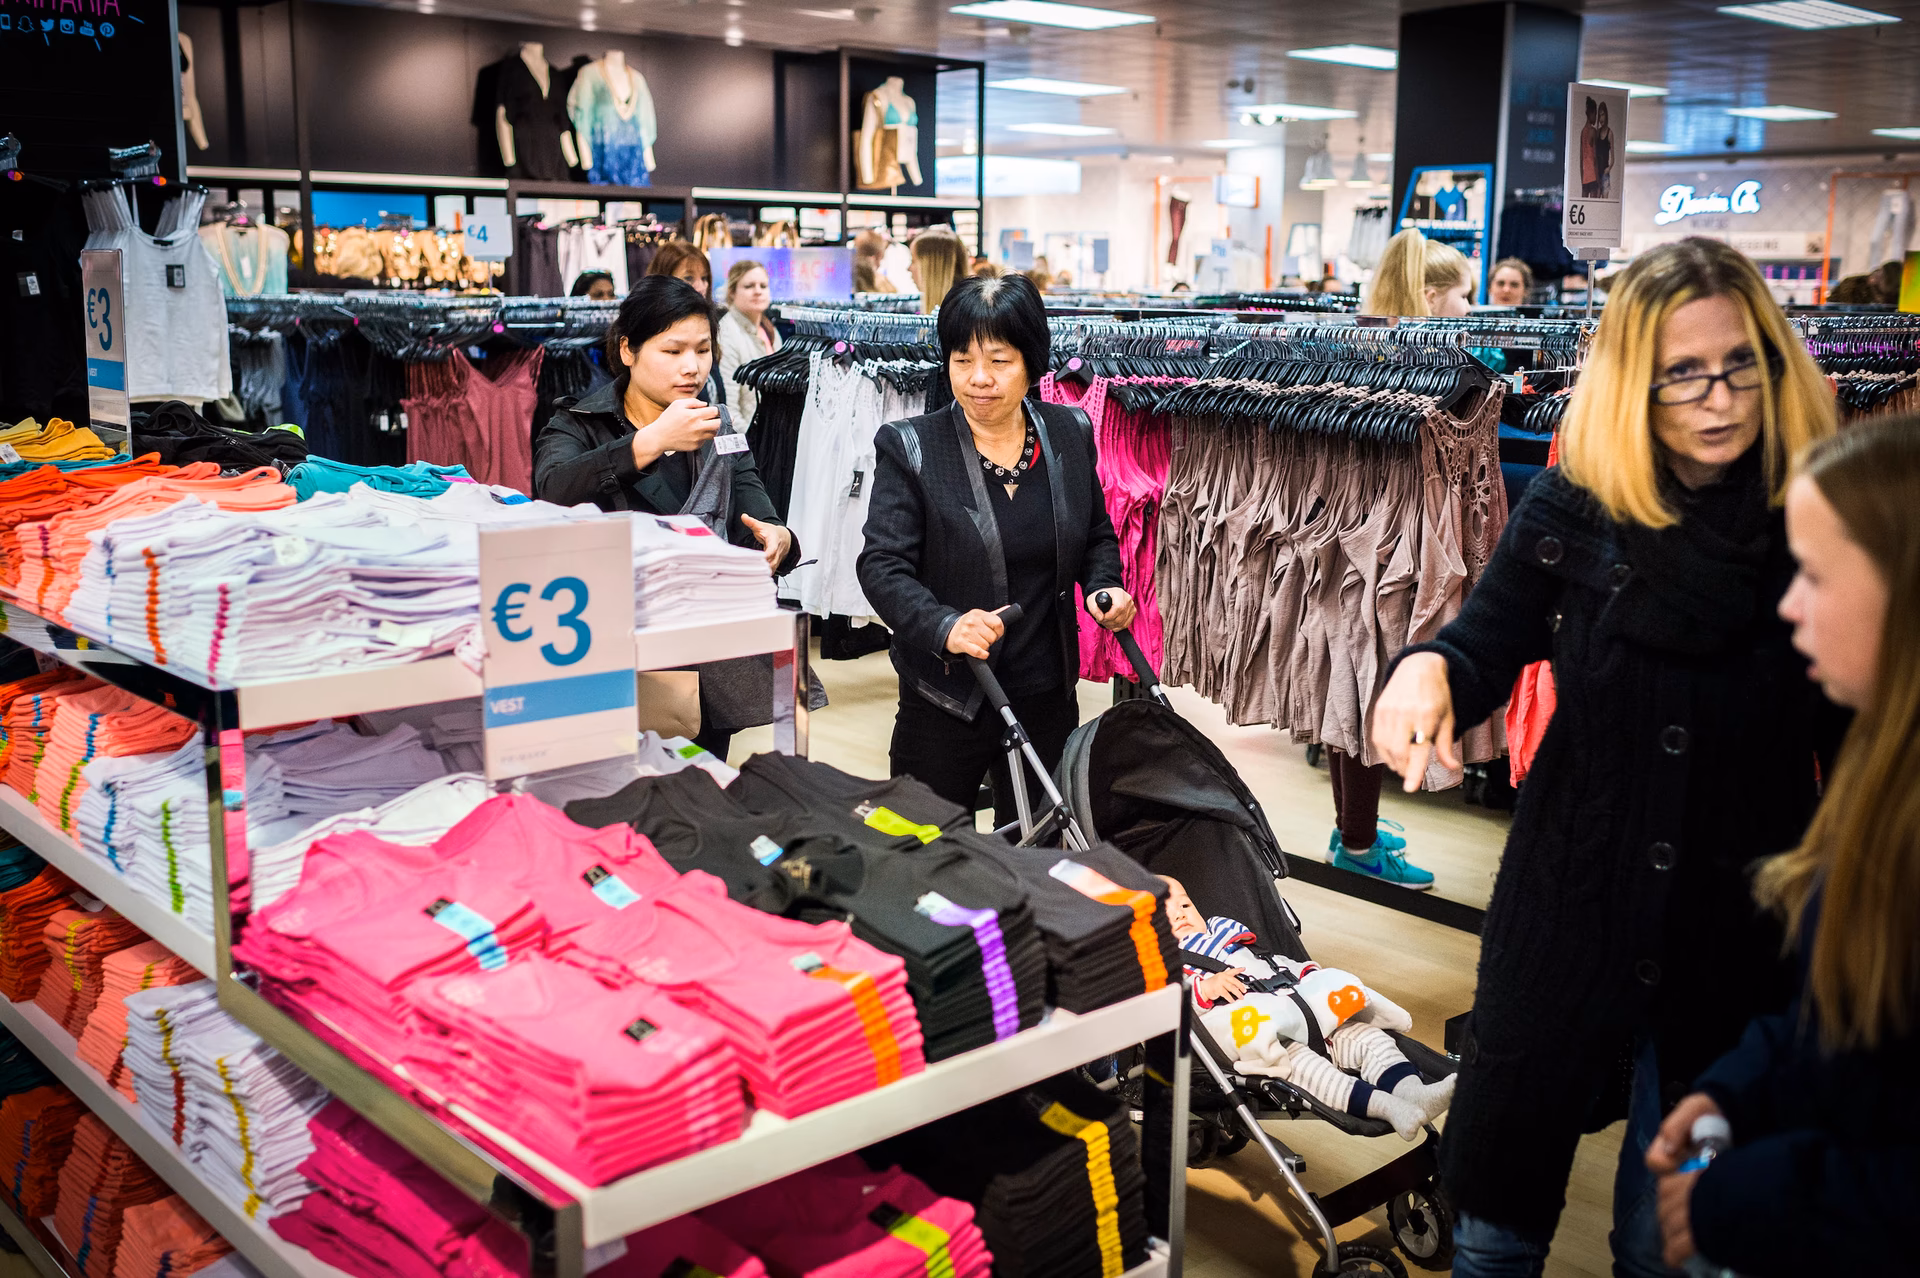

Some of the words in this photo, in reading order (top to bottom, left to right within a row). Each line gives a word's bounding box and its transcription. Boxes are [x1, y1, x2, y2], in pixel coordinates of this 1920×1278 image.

[1569, 204, 1586, 225] €6
[467, 225, 489, 243] €4
[87, 287, 113, 351] €3
[490, 576, 592, 666] €3
[490, 696, 526, 715] VEST
